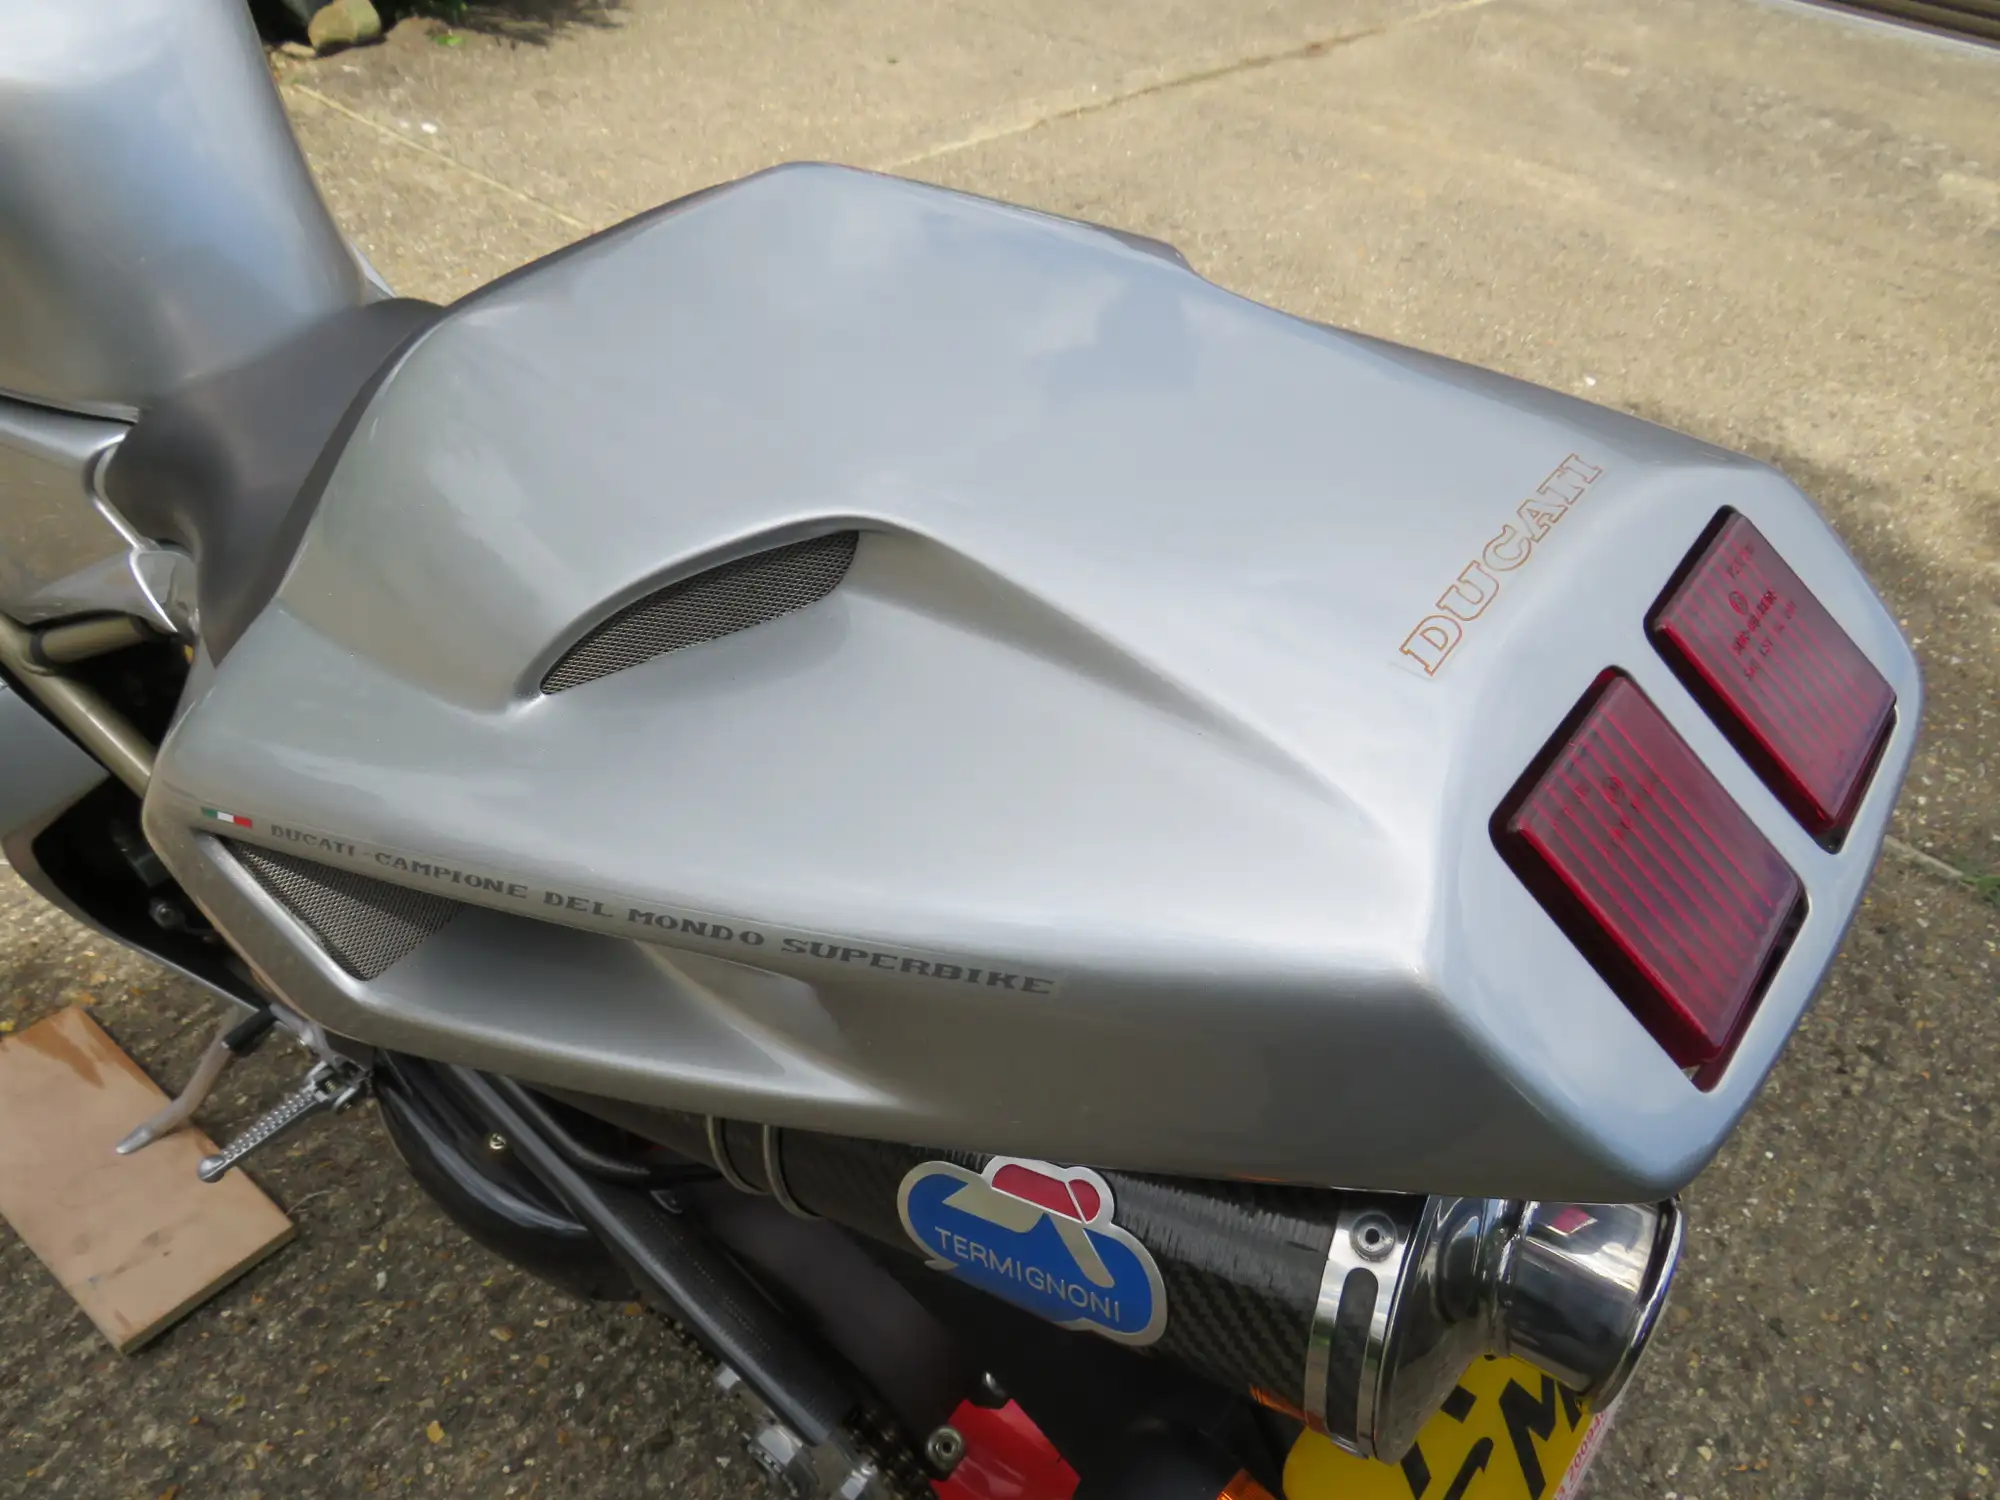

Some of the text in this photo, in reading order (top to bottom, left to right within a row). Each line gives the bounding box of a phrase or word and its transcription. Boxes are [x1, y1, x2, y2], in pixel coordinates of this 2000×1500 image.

[1399, 453, 1603, 676] DUCATI
[542, 891, 614, 918] DEL
[627, 908, 765, 946] MONDO
[780, 936, 1056, 995] SUPERBIKE
[934, 1226, 1120, 1322] TERMIGNONI
